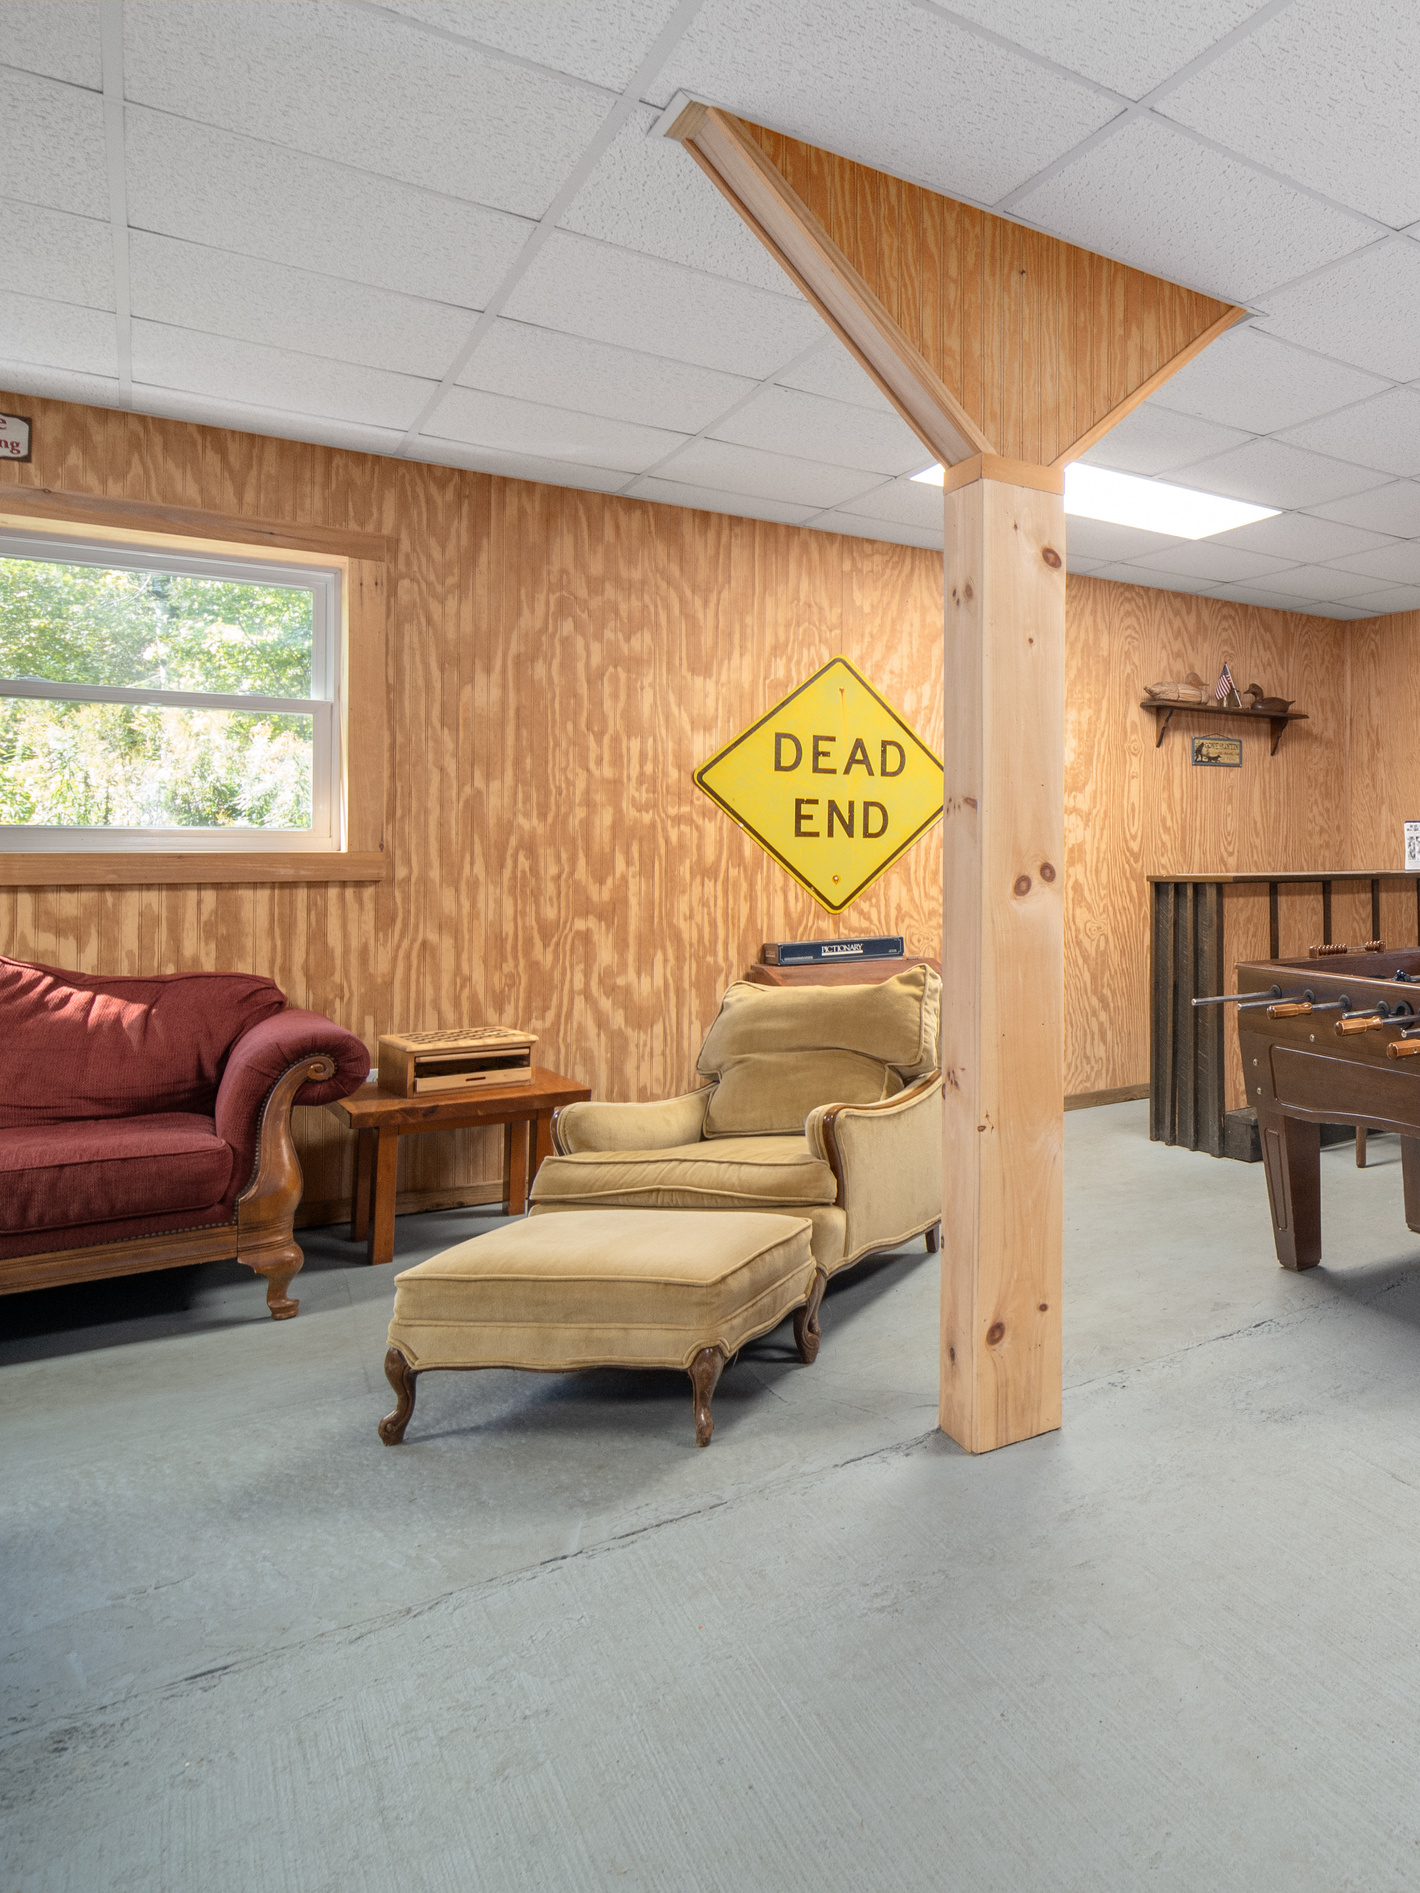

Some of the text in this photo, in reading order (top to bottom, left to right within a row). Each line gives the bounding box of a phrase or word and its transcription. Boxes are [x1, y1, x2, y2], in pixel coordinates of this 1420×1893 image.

[774, 731, 906, 778] DEAD
[794, 798, 889, 839] END
[821, 943, 863, 954] PICTIONARY
